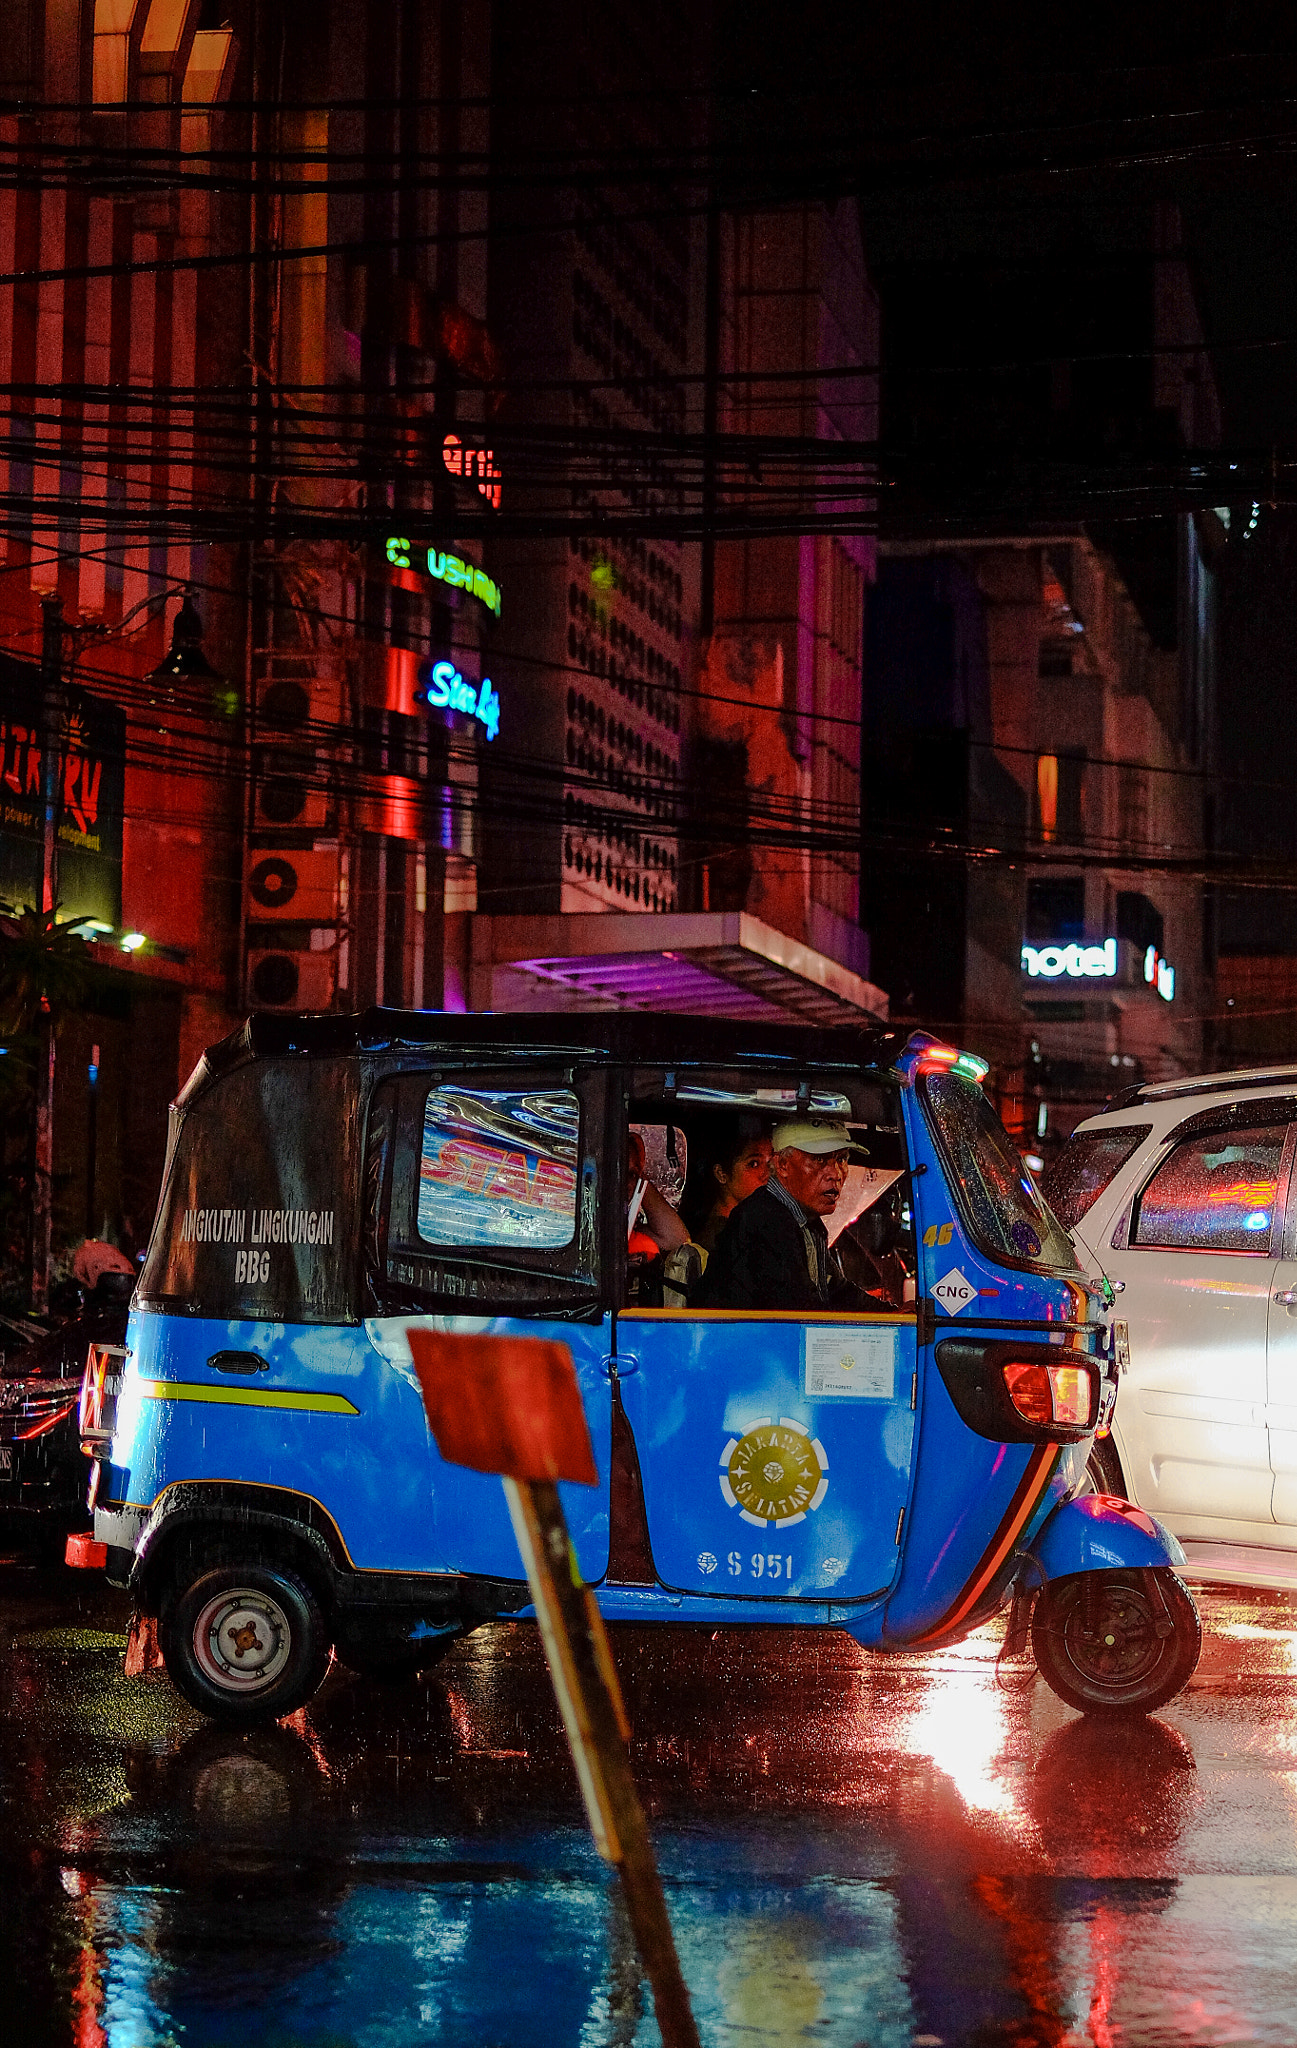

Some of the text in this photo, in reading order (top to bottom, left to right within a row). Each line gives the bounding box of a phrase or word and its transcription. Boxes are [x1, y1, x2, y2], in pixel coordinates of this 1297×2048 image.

[179, 1209, 334, 1245] ANGKUTAN LINGKUNGAN
[923, 1222, 954, 1248] 46
[235, 1250, 271, 1284] BBG
[936, 1286, 969, 1299] CNG
[738, 1433, 811, 1465] JAKARTA
[735, 1481, 810, 1516] SELATAN
[727, 1551, 792, 1579] S 951
